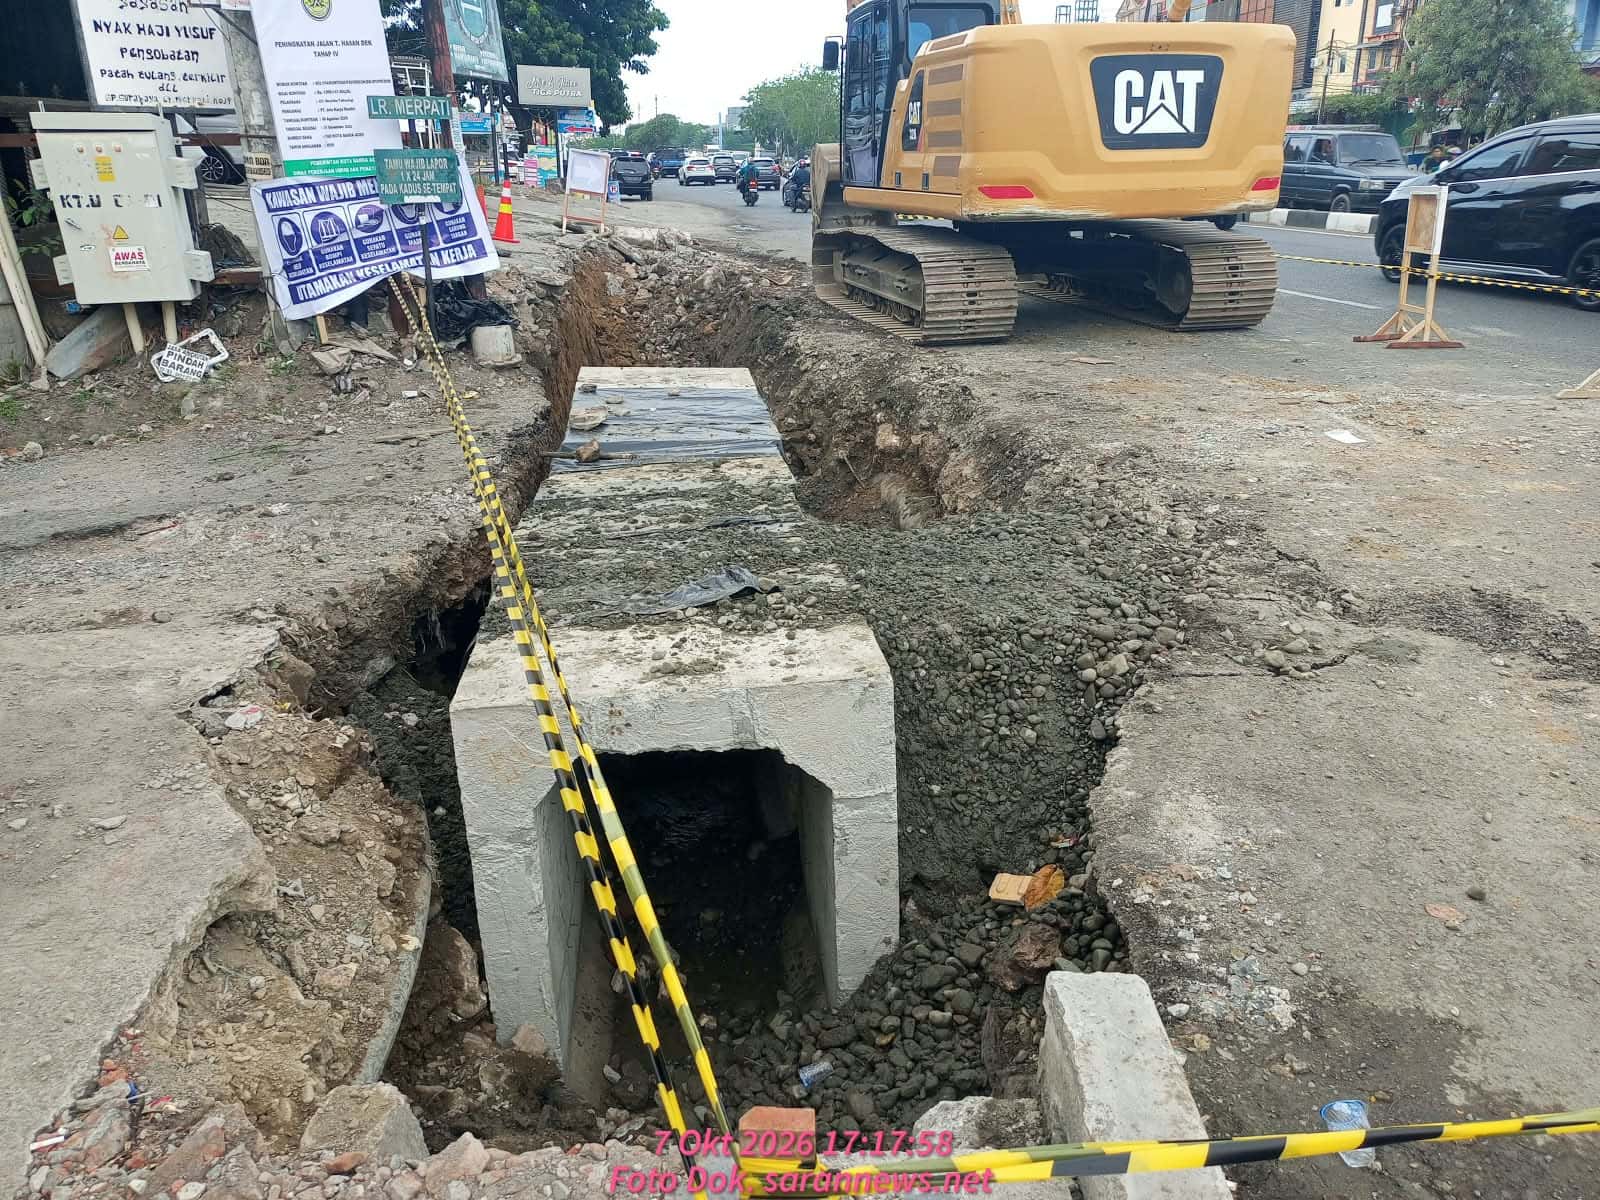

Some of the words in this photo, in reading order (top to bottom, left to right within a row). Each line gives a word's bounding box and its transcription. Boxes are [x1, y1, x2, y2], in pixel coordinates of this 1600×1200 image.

[93, 20, 132, 35] NYAK
[136, 24, 170, 37] HAJI
[175, 25, 217, 40] YUSUF
[370, 98, 391, 115] LR.
[395, 98, 451, 116] MERPATI
[1114, 69, 1204, 135] CAT
[908, 101, 921, 125] CAT
[384, 158, 404, 169] TAMU
[405, 158, 425, 169] WAJIB
[425, 158, 448, 169] LAPOR
[412, 171, 421, 181] 24
[422, 171, 435, 181] JAM
[265, 187, 317, 209] KAWASAN
[317, 181, 357, 202] WAJIB
[381, 184, 398, 194] PADA
[400, 183, 422, 194] KADUS
[423, 182, 457, 194] SE-TEMPAT
[114, 251, 144, 260] AWAS
[440, 244, 477, 265] KERJA
[166, 350, 205, 369] PINDAH
[161, 360, 202, 378] BARANG
